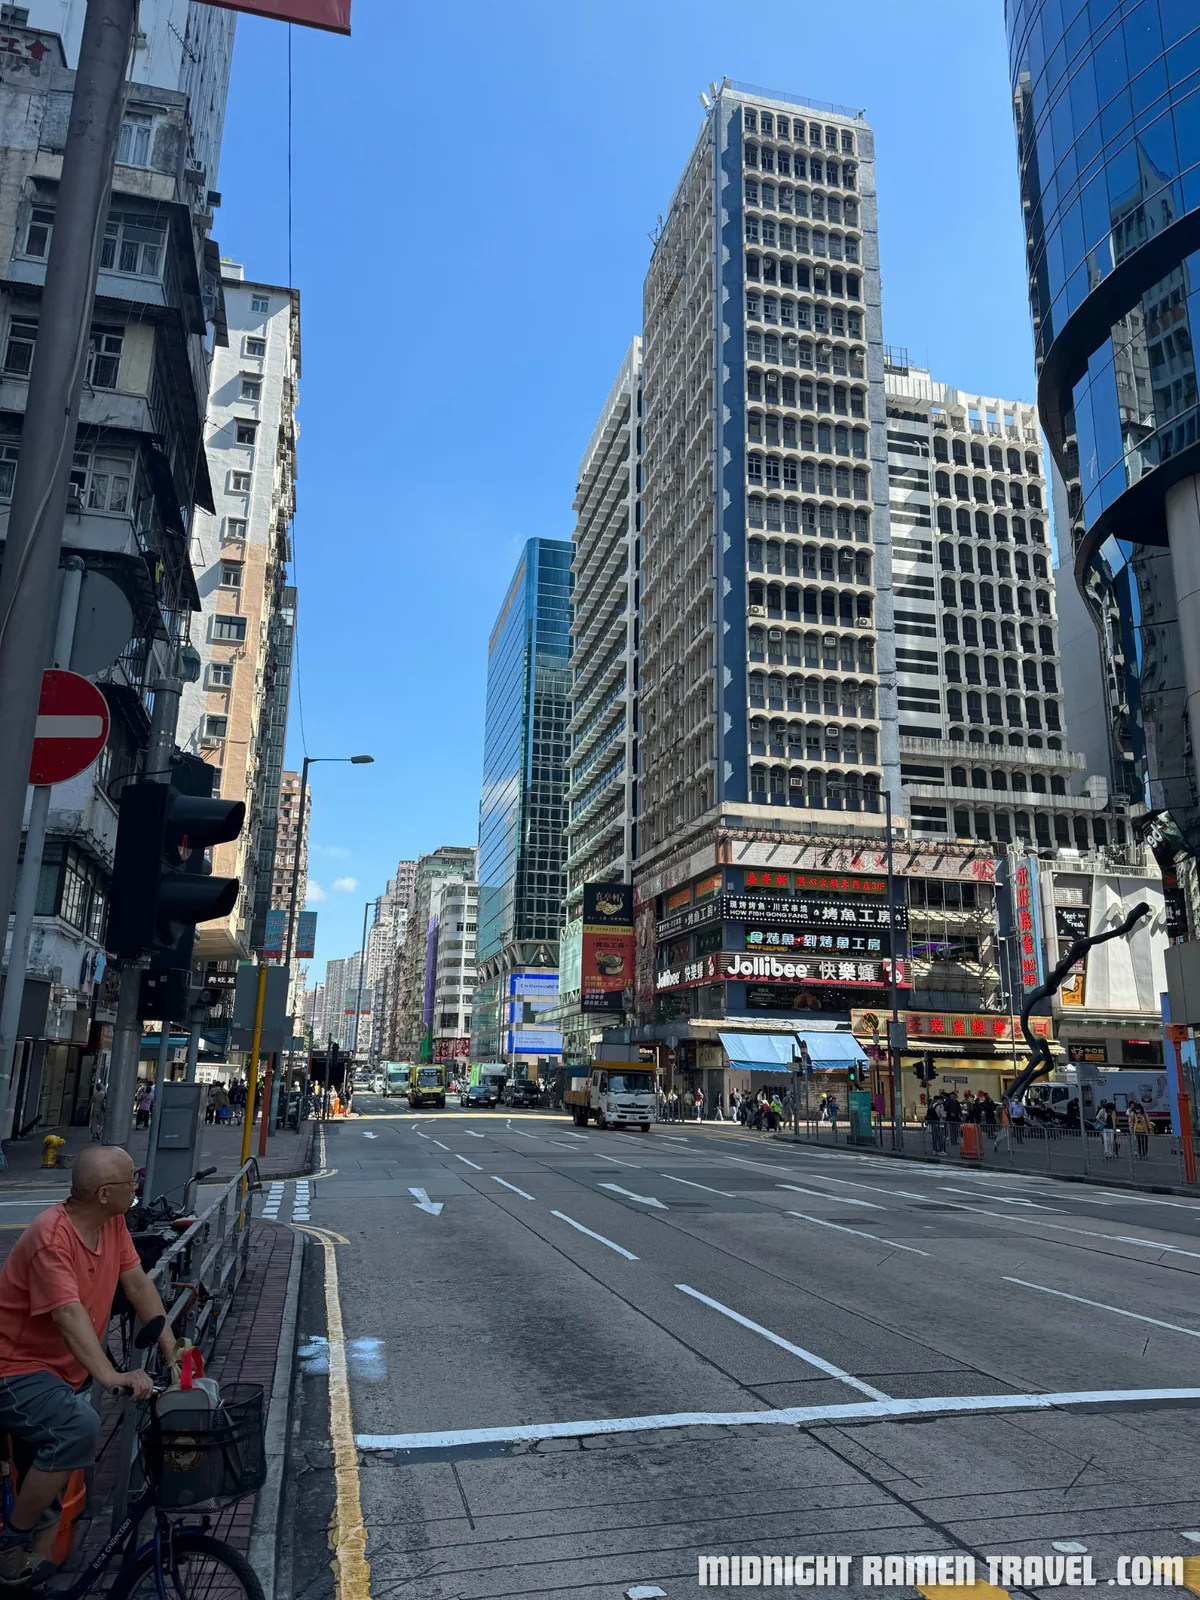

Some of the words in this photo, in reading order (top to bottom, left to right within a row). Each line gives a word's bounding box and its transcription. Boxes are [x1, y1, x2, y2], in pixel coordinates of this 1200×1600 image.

[822, 906, 891, 923] 烤魚工房
[727, 954, 808, 979] Jollibee
[819, 961, 875, 982] 快樂蜂
[92, 1553, 107, 1569] luna
[105, 1518, 132, 1553] collection
